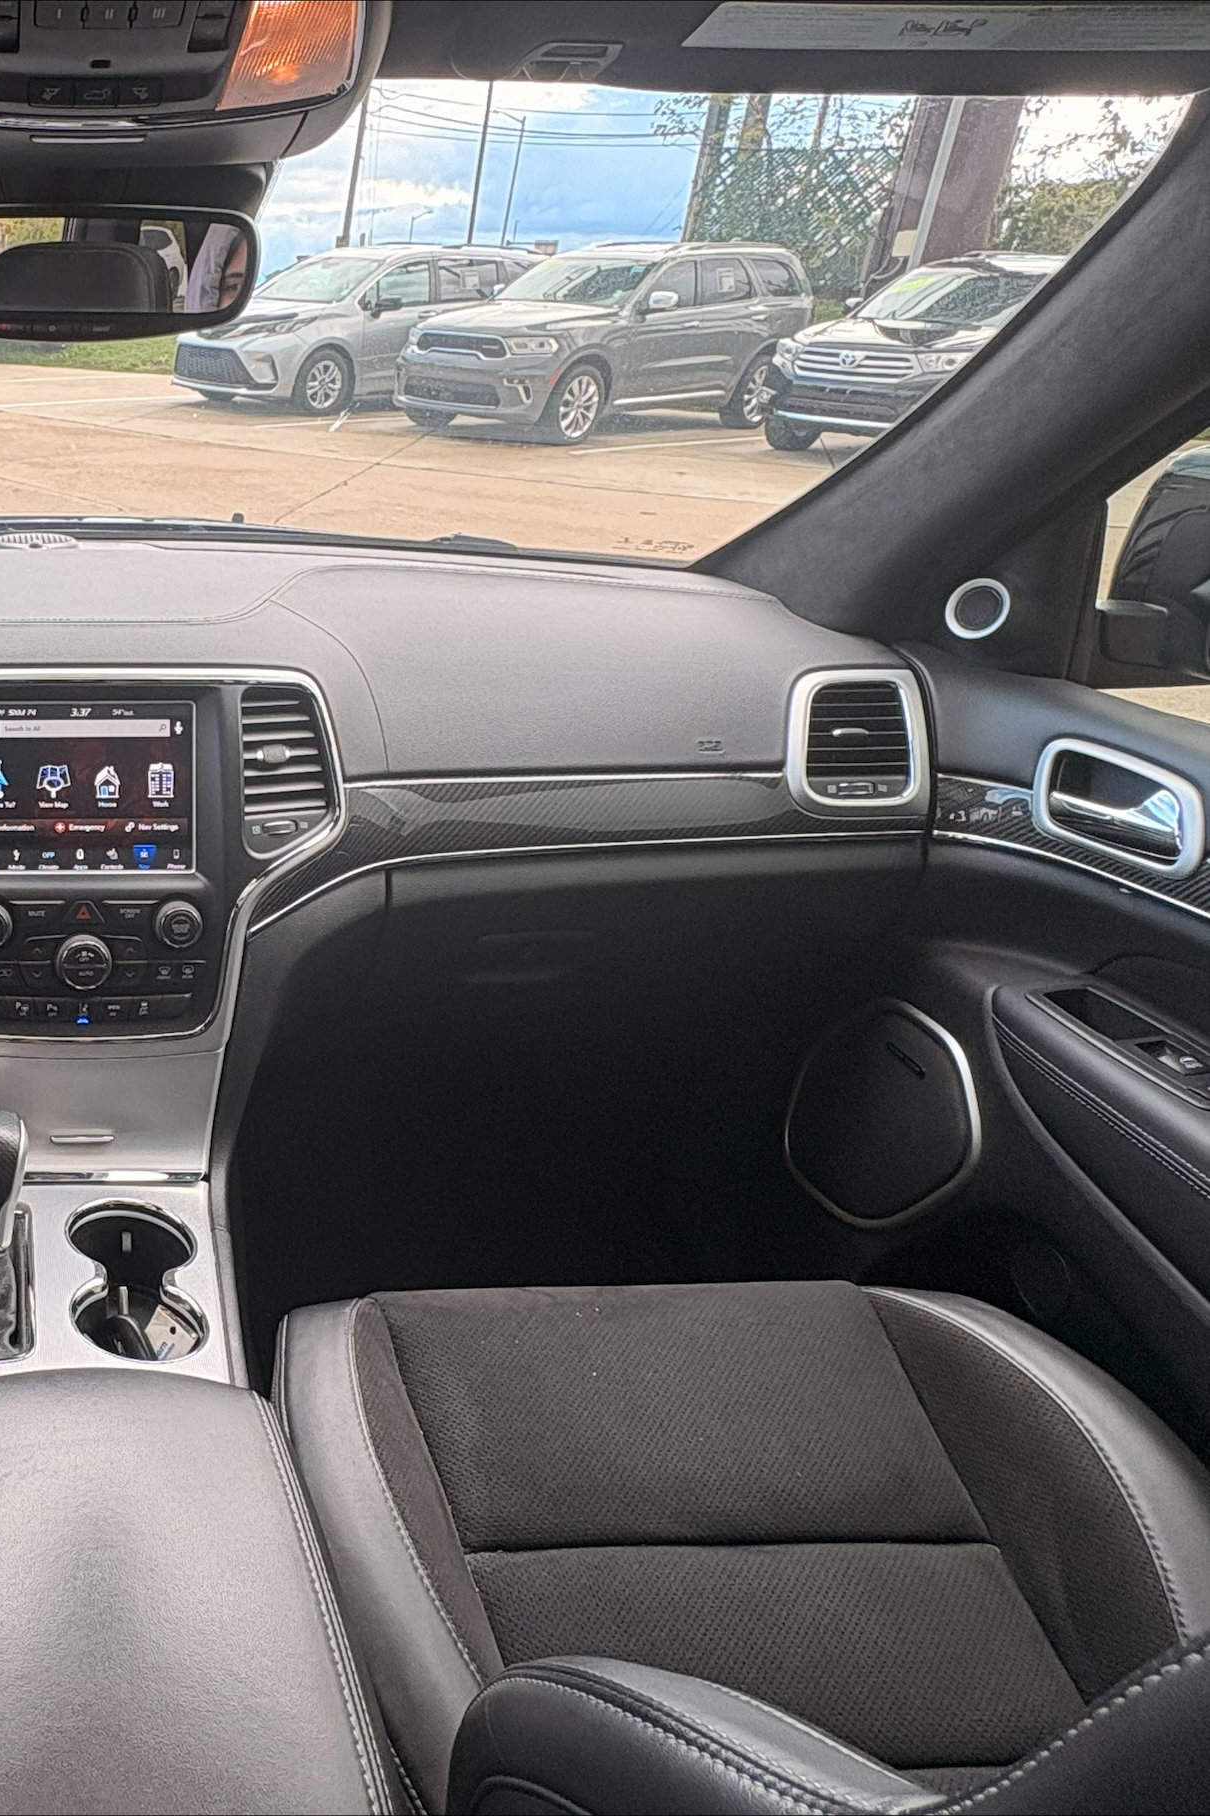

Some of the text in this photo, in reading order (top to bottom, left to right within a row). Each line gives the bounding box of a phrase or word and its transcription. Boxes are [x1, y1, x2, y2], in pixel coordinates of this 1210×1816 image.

[26, 708, 36, 716] 74
[53, 802, 68, 810] Map
[68, 824, 106, 833] Emergency
[138, 824, 179, 832] Nav Settings
